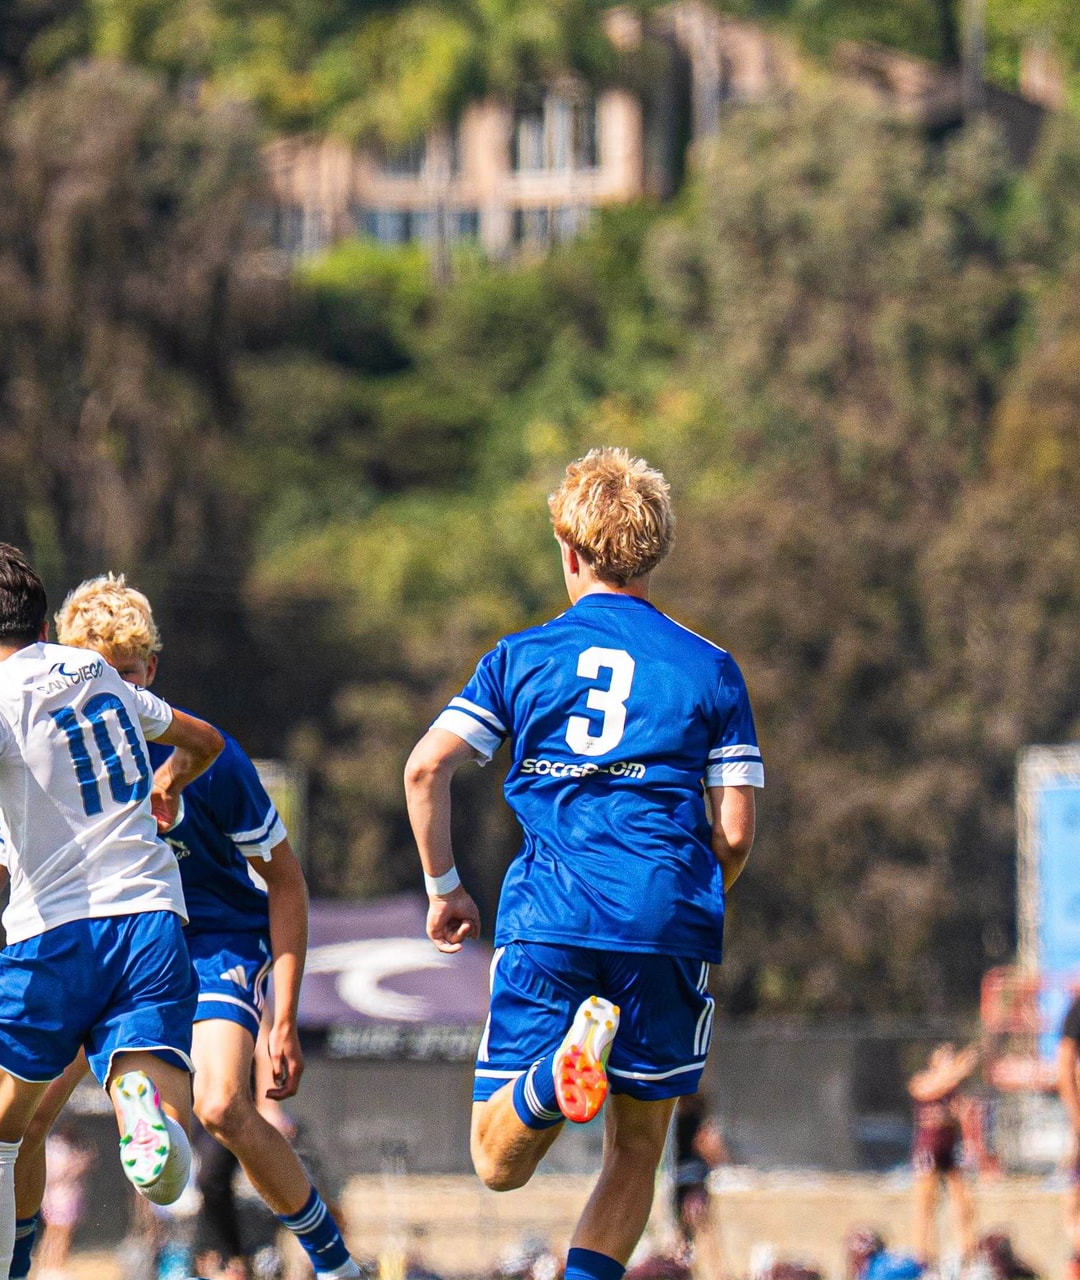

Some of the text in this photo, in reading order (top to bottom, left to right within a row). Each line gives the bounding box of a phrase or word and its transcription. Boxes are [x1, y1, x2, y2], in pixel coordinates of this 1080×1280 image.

[36, 660, 104, 695] SAN DIEGO
[564, 646, 636, 757] 3
[48, 692, 150, 817] 10
[520, 758, 646, 779] SOCCEROM
